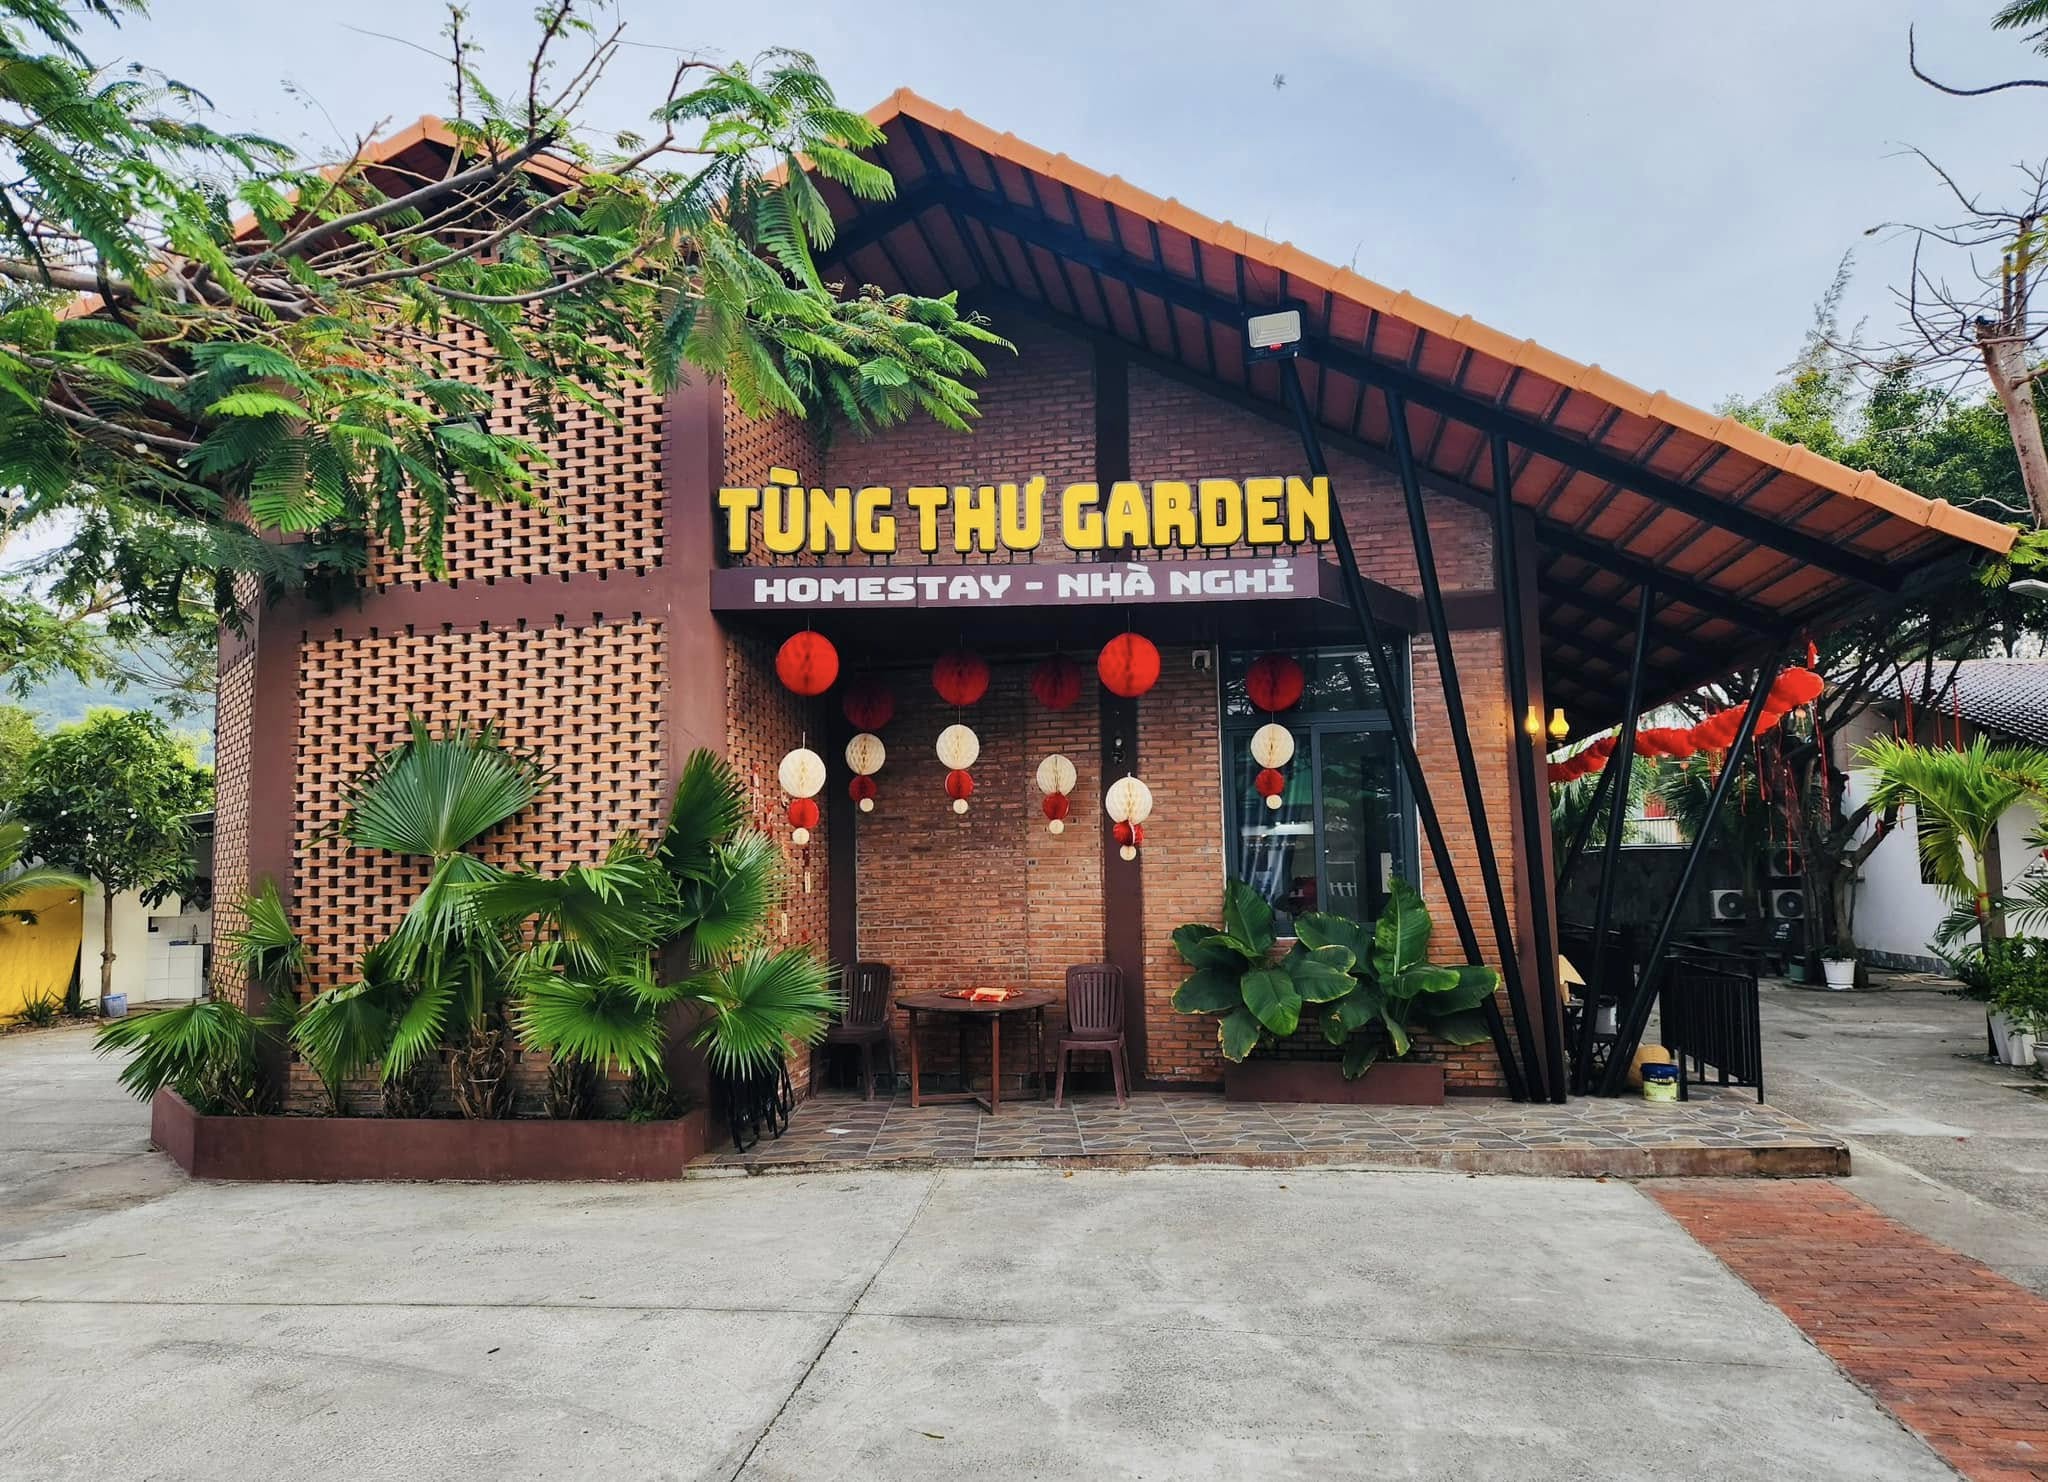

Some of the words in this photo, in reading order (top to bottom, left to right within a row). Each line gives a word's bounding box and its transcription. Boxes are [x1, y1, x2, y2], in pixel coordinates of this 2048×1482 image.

[718, 466, 897, 554] TÙNG
[907, 475, 1048, 553] THƯ
[1061, 475, 1332, 550] GARDEN
[753, 575, 1012, 603] HOMESTAY
[1057, 562, 1156, 598] NHÀ
[1169, 558, 1295, 596] NGHỈ
